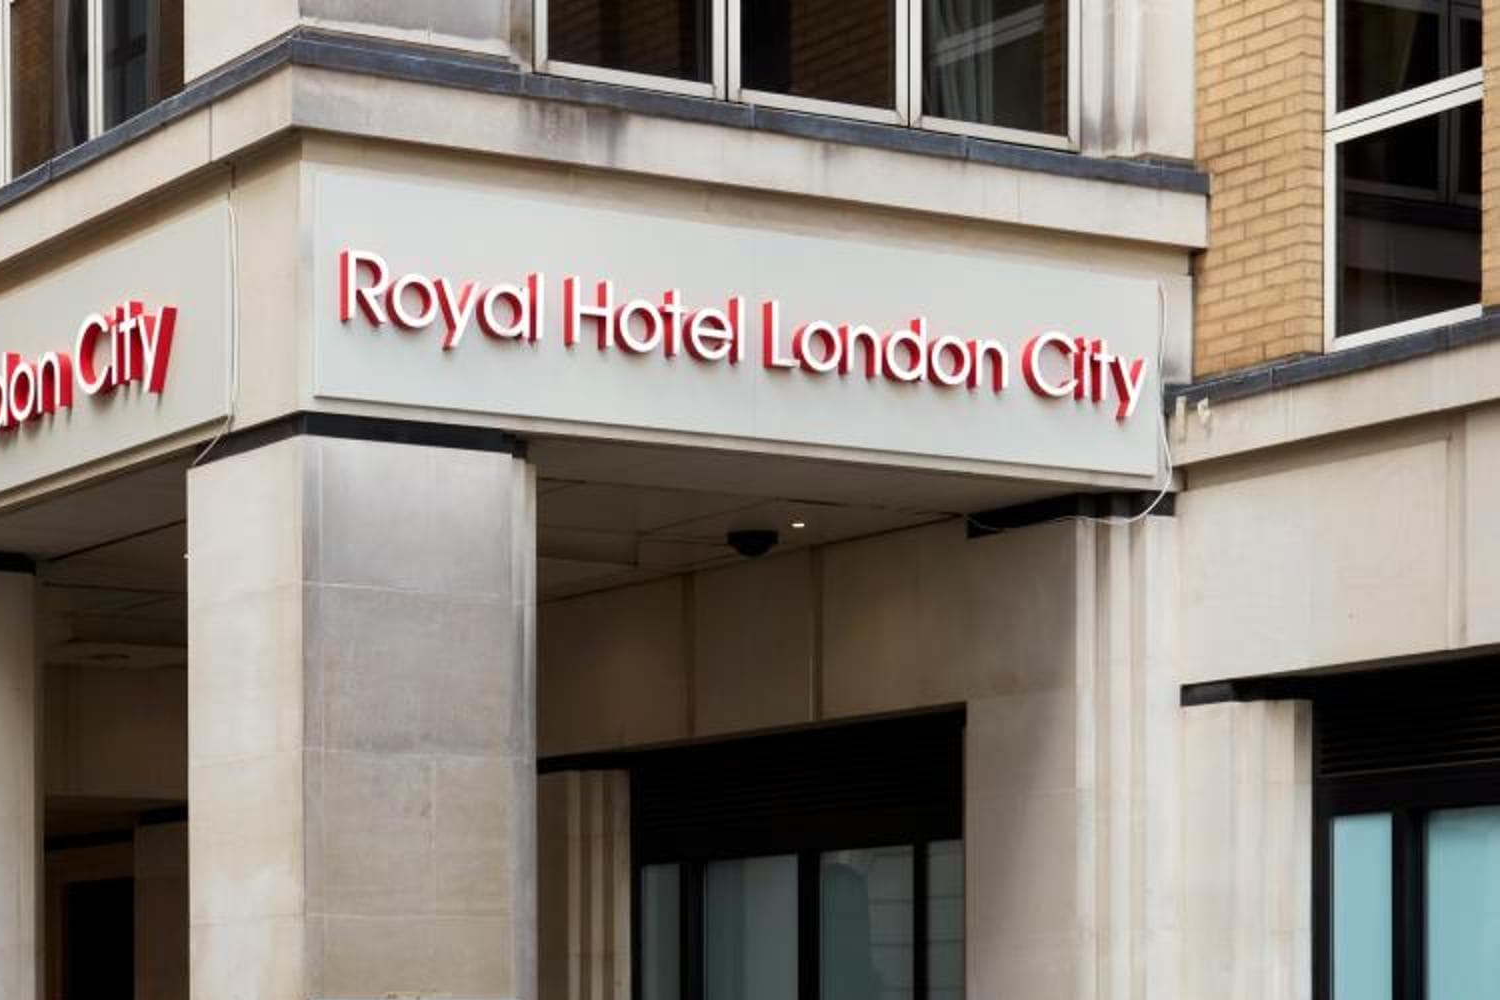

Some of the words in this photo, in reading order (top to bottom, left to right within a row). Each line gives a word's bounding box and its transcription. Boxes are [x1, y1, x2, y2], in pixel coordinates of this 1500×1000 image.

[76, 300, 177, 394] City
[339, 247, 544, 350] Royal
[563, 274, 746, 366] Hotel
[762, 299, 1007, 393] London
[1022, 329, 1148, 420] City
